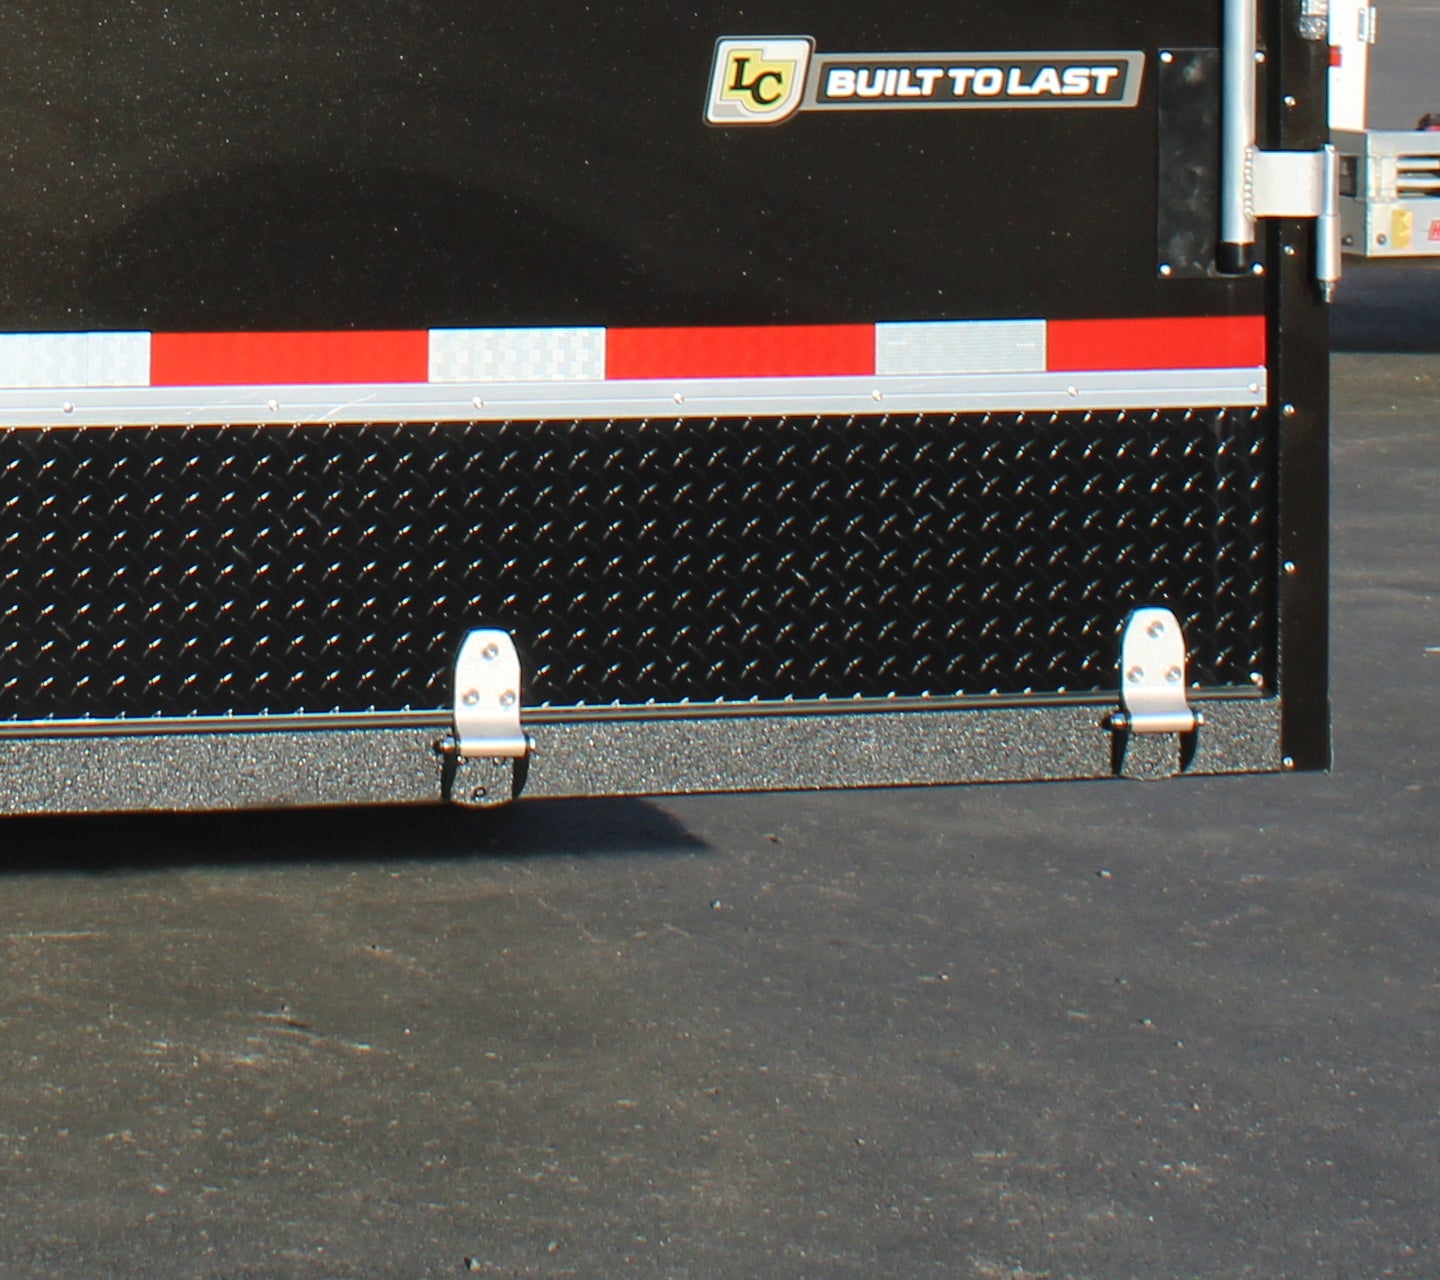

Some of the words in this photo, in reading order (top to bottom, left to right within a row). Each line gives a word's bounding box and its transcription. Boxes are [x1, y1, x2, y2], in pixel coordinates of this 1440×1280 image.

[729, 57, 783, 105] LC
[825, 67, 945, 98] BUILT
[947, 67, 1004, 97] TO
[1006, 66, 1119, 97] LAST
